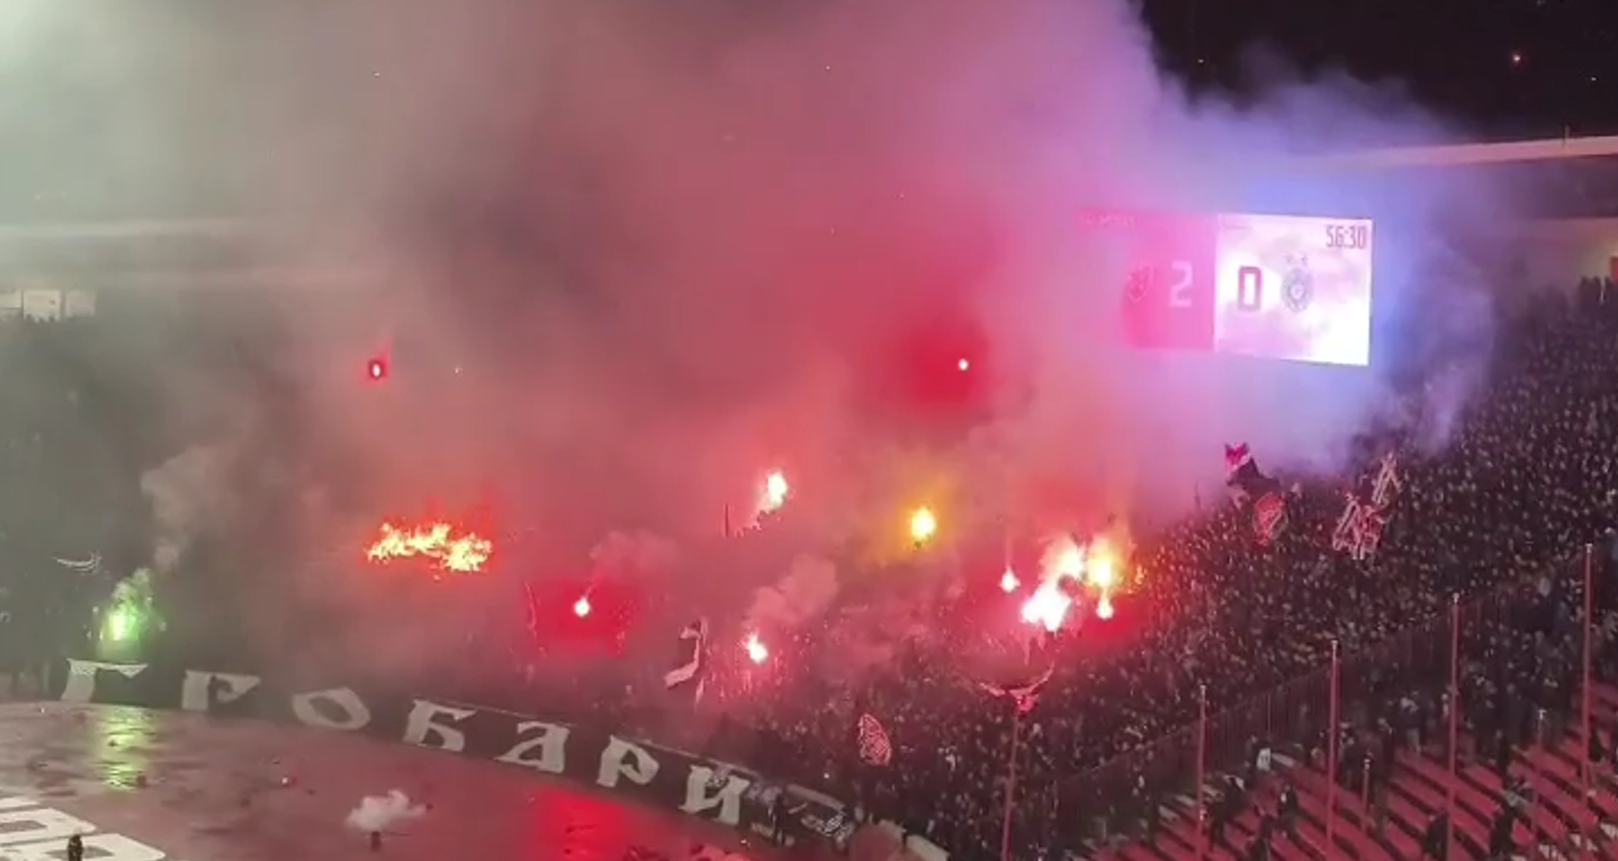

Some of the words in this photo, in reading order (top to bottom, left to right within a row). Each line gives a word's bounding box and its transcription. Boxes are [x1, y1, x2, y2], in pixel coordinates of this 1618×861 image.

[1325, 225, 1367, 250] 56:30
[1169, 261, 1193, 307] 2
[1237, 265, 1262, 311] 0
[61, 658, 751, 825] ГРОБАРИ
